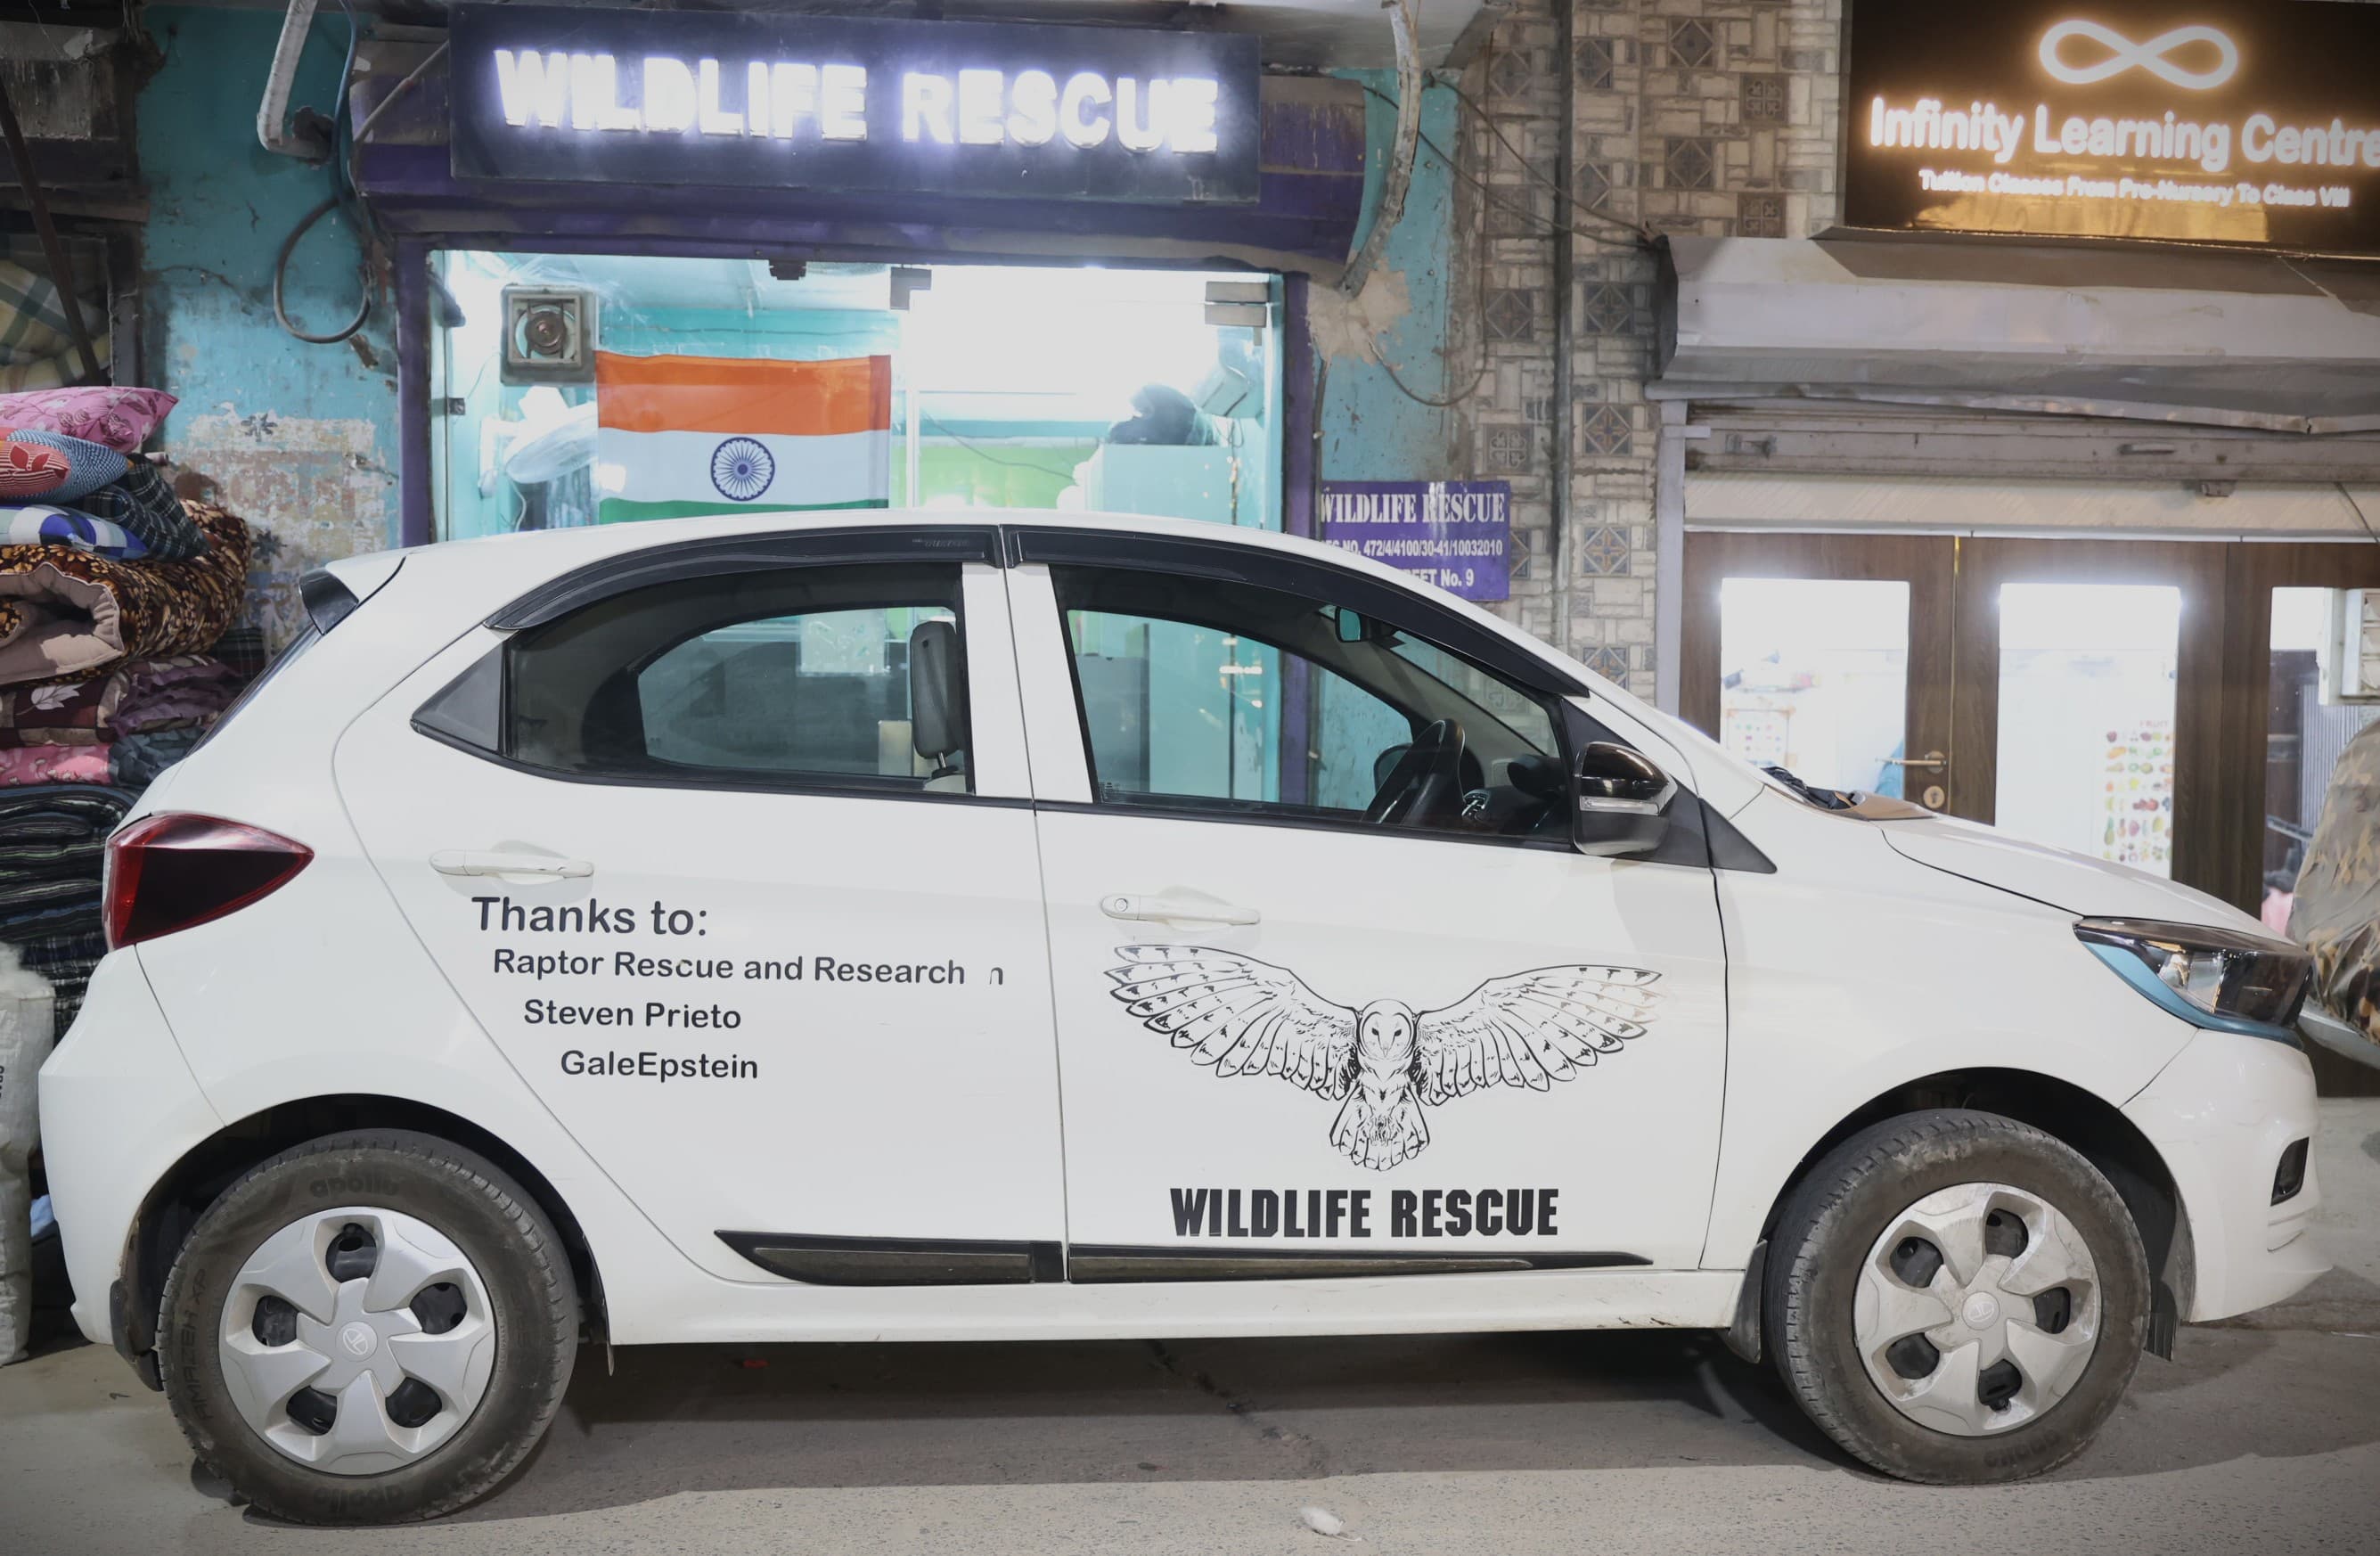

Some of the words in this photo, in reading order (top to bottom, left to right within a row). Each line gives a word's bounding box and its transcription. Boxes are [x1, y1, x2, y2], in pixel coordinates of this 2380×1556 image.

[495, 49, 869, 141] WILDLIFE
[901, 69, 1220, 154] RESCUE
[1870, 97, 2024, 163] Infinity
[2034, 104, 2229, 172] Learning
[2236, 182, 2261, 204] To
[2262, 184, 2317, 207] Class
[1321, 493, 1417, 523] WILDLIFE
[1422, 492, 1505, 523] RESCUE
[1440, 568, 1463, 588] No.
[1466, 568, 1476, 587] 9
[471, 897, 635, 935] Thanks
[651, 901, 707, 937] to:
[494, 949, 605, 981] Raptor
[614, 951, 734, 979] Rescue
[744, 956, 803, 980] and
[814, 956, 965, 985] Research
[524, 998, 634, 1027] Steven
[645, 1003, 741, 1029] Prieto
[560, 1050, 758, 1084] GaleEpstein
[1170, 1188, 1371, 1238] WILDLIFE
[1391, 1188, 1559, 1238] RESCUE
